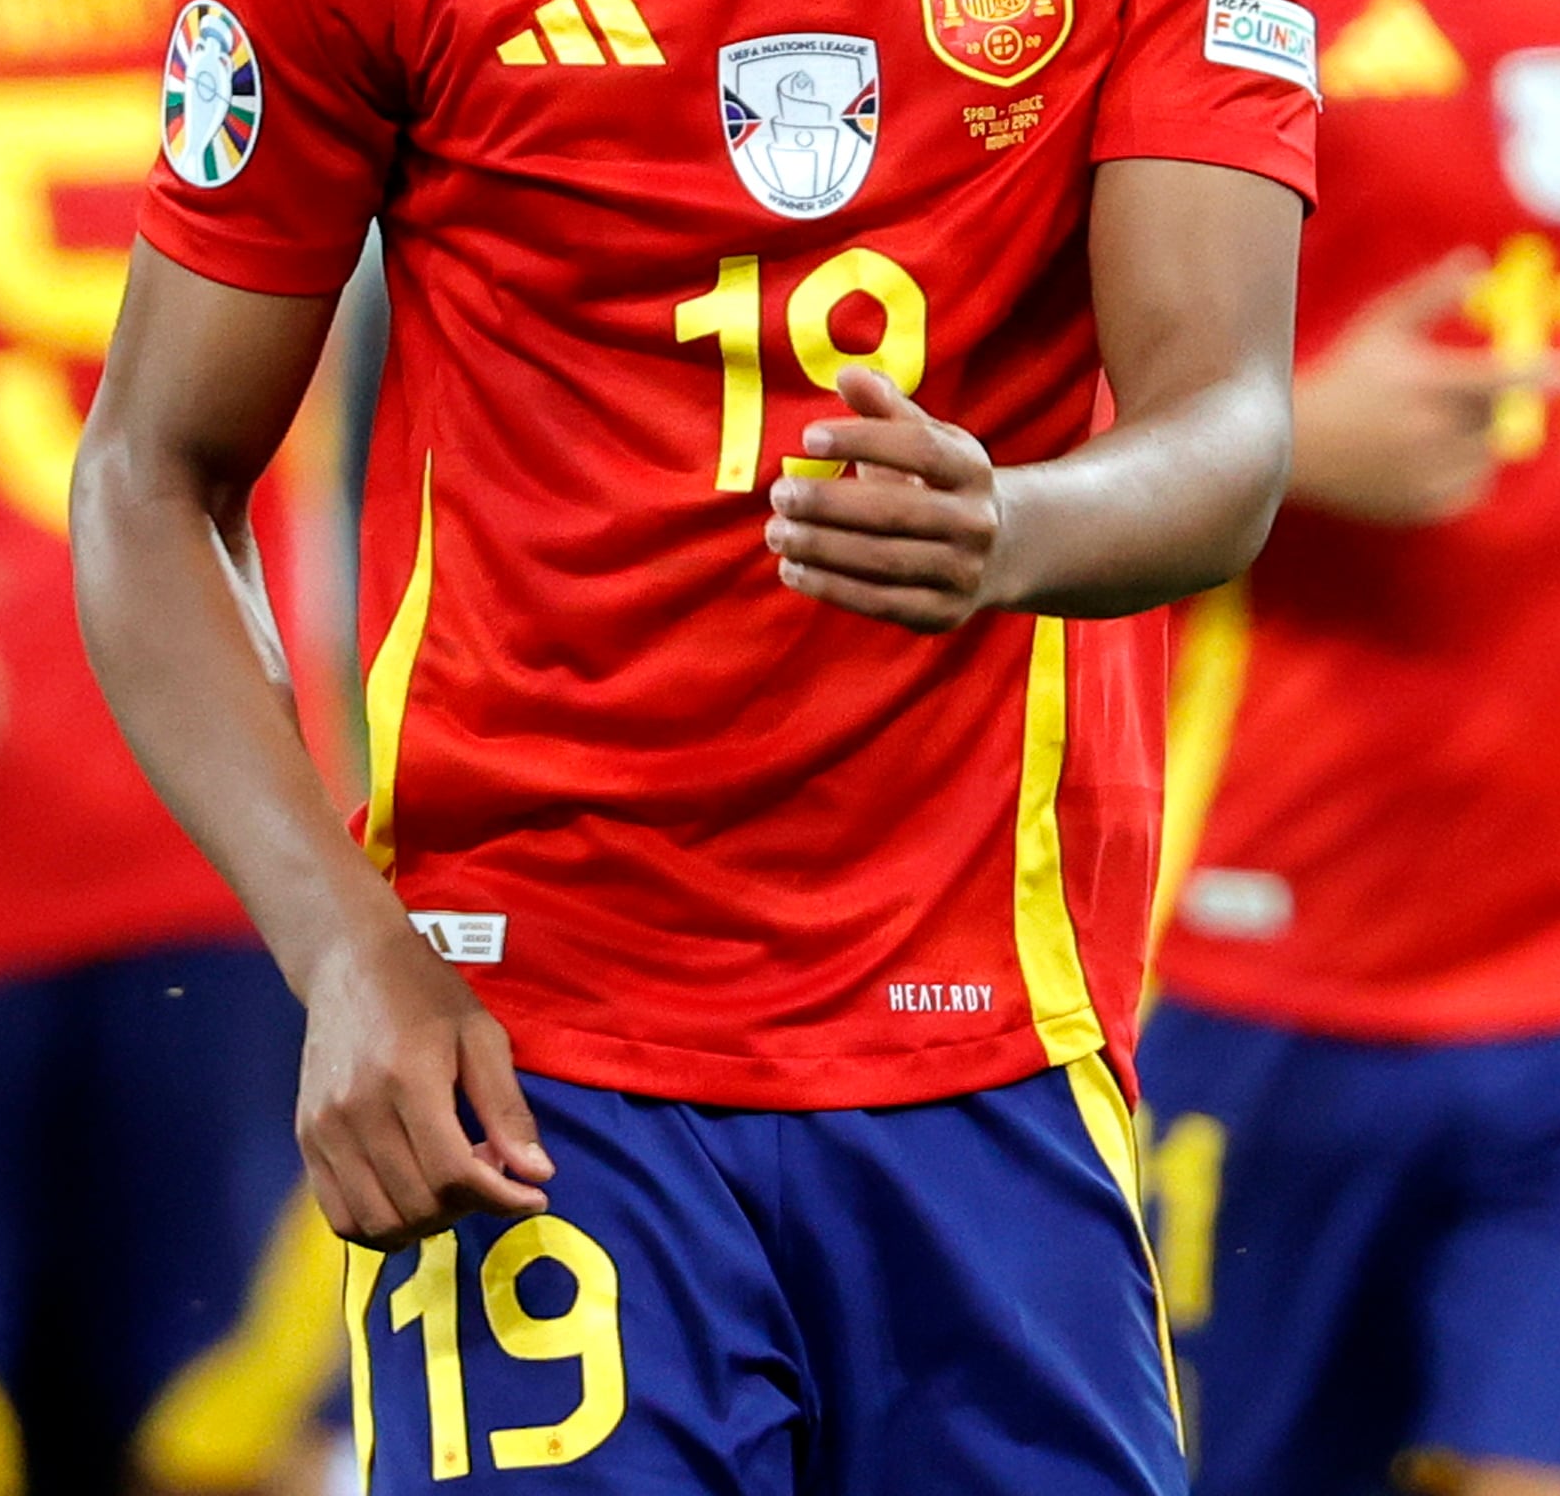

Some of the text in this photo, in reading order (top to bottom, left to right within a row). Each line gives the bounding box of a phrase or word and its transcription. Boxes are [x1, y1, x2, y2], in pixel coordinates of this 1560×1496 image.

[728, 41, 869, 62] UEFA NATIONS LEAGUE
[768, 192, 816, 212] WINNER
[675, 246, 928, 493] 19
[888, 983, 992, 1012] HEAT.RDY
[389, 1213, 628, 1482] 19
